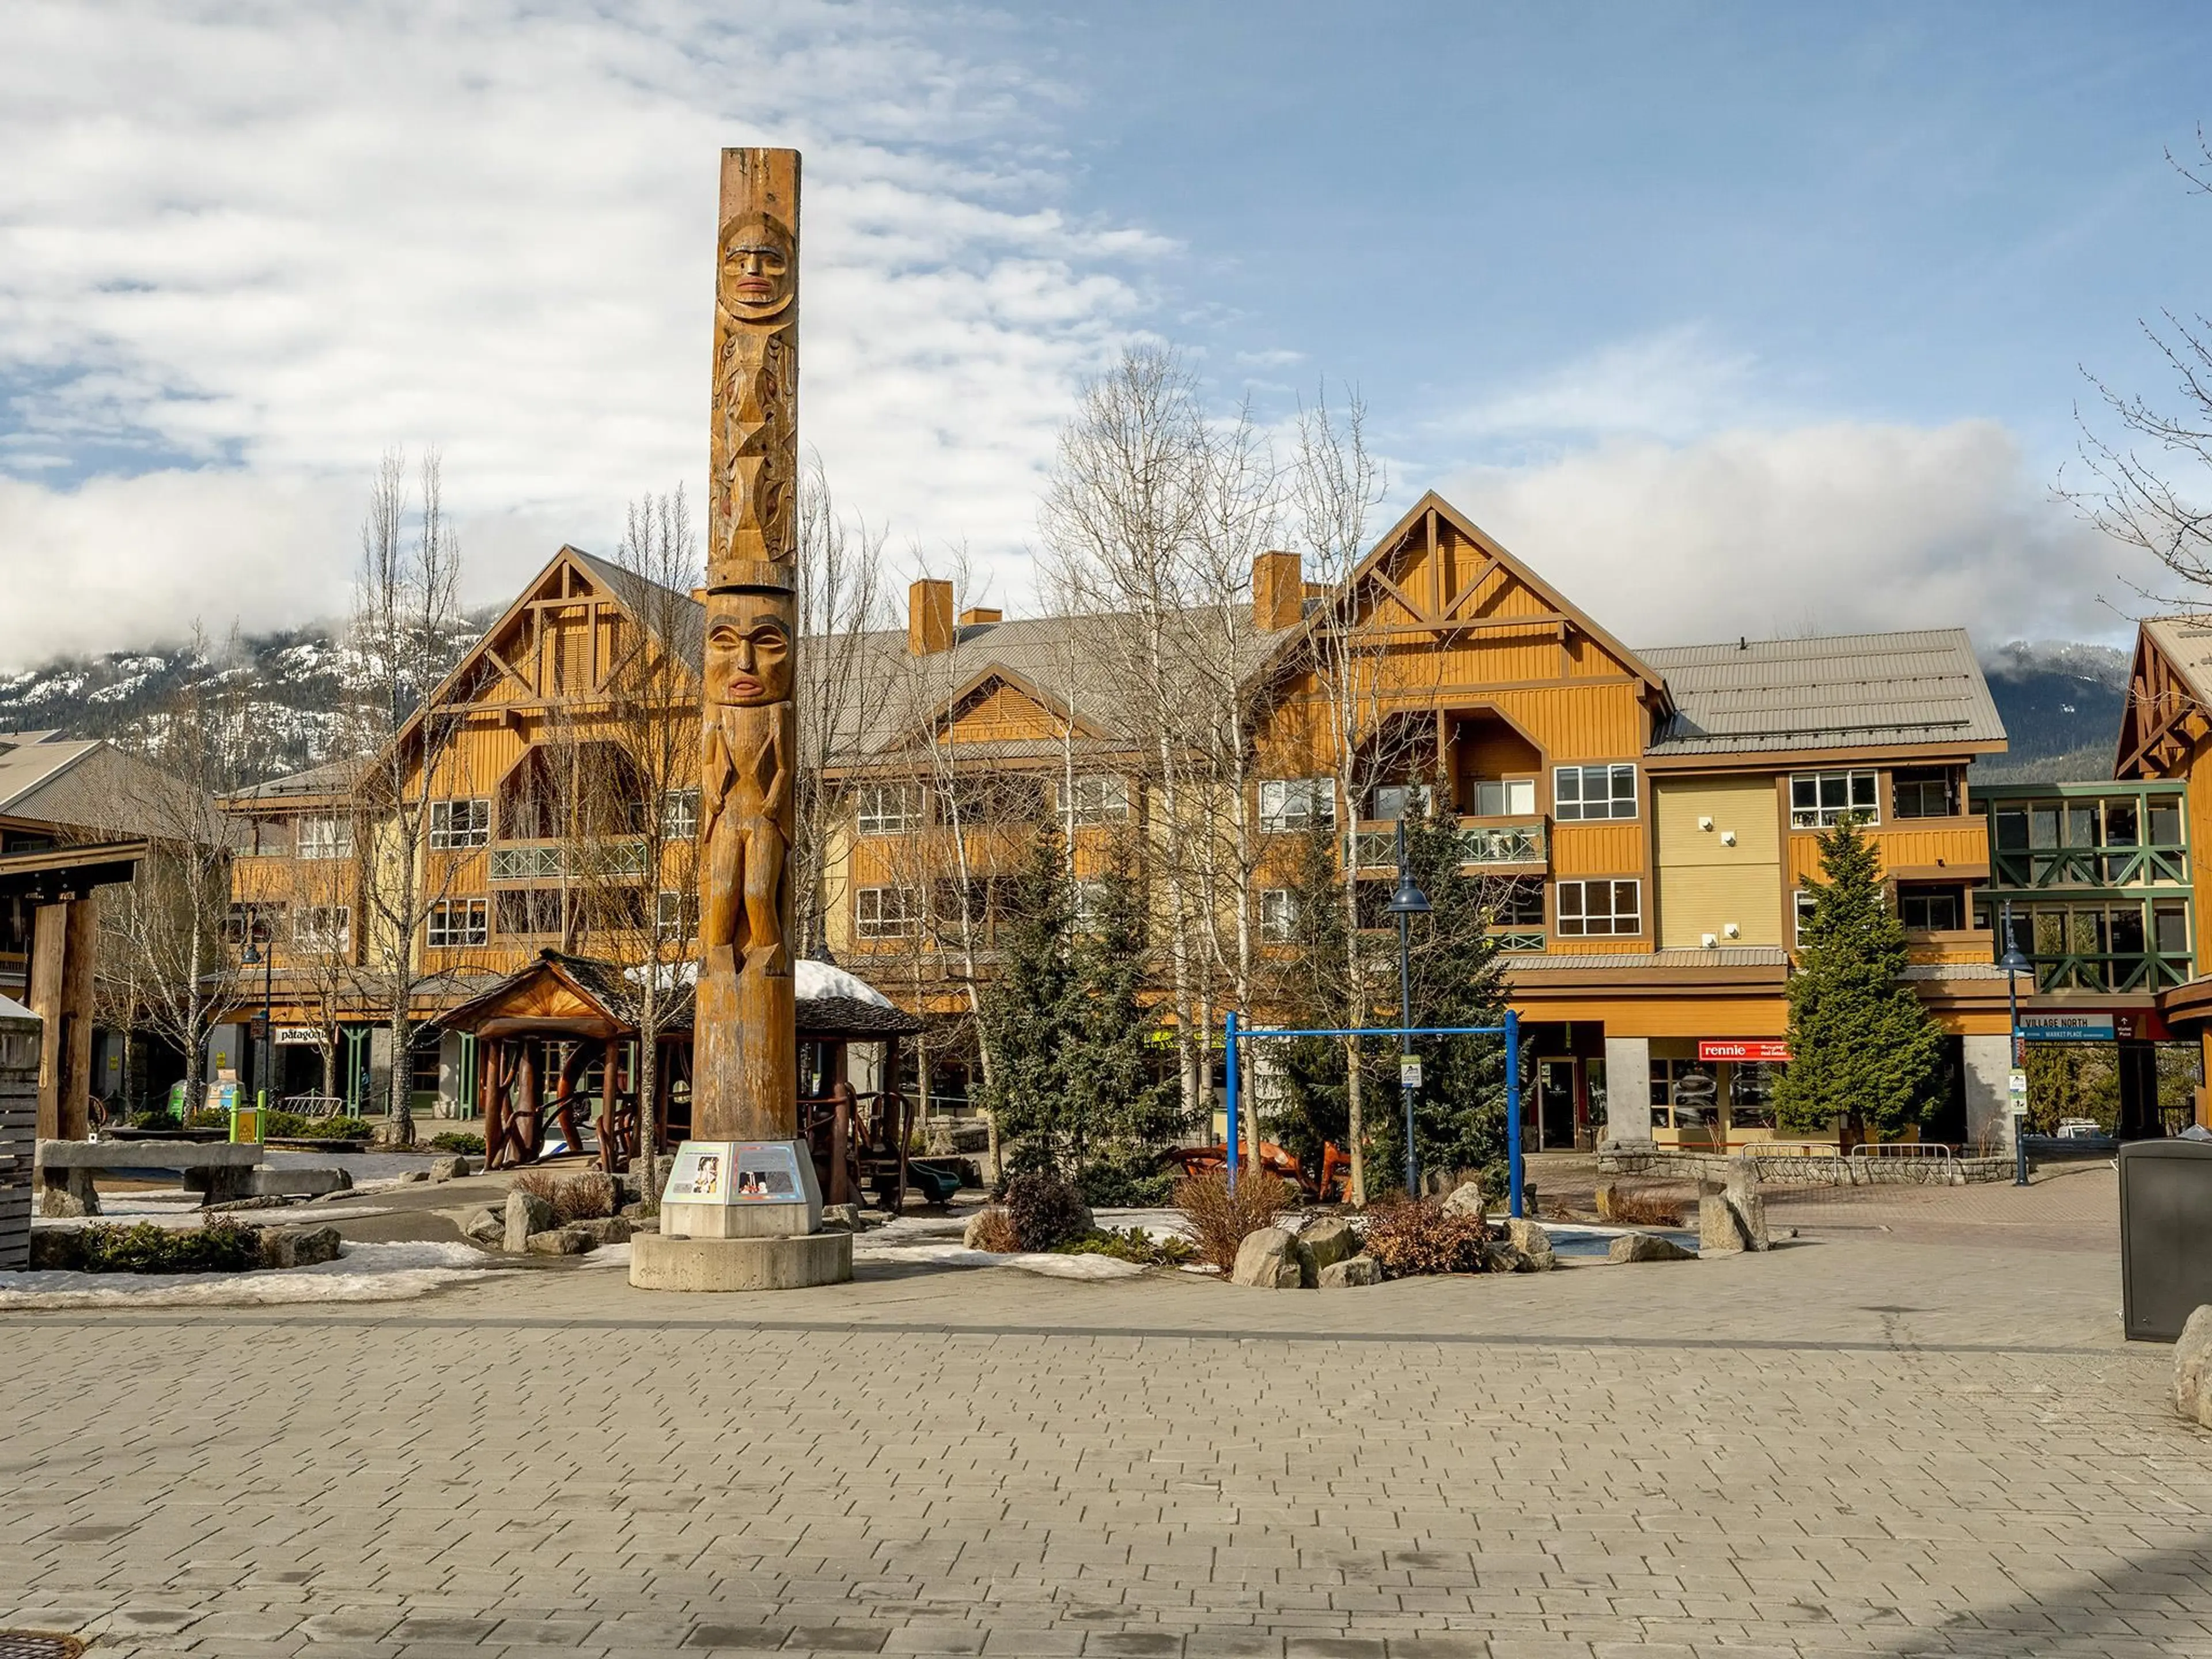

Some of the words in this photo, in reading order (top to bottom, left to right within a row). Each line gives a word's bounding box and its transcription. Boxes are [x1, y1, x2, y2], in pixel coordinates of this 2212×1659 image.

[2025, 1018, 2058, 1028] VILLAGE
[2062, 1018, 2088, 1028] NORTH
[282, 1030, 327, 1041] patagoni
[1705, 1044, 1745, 1055] rennie
